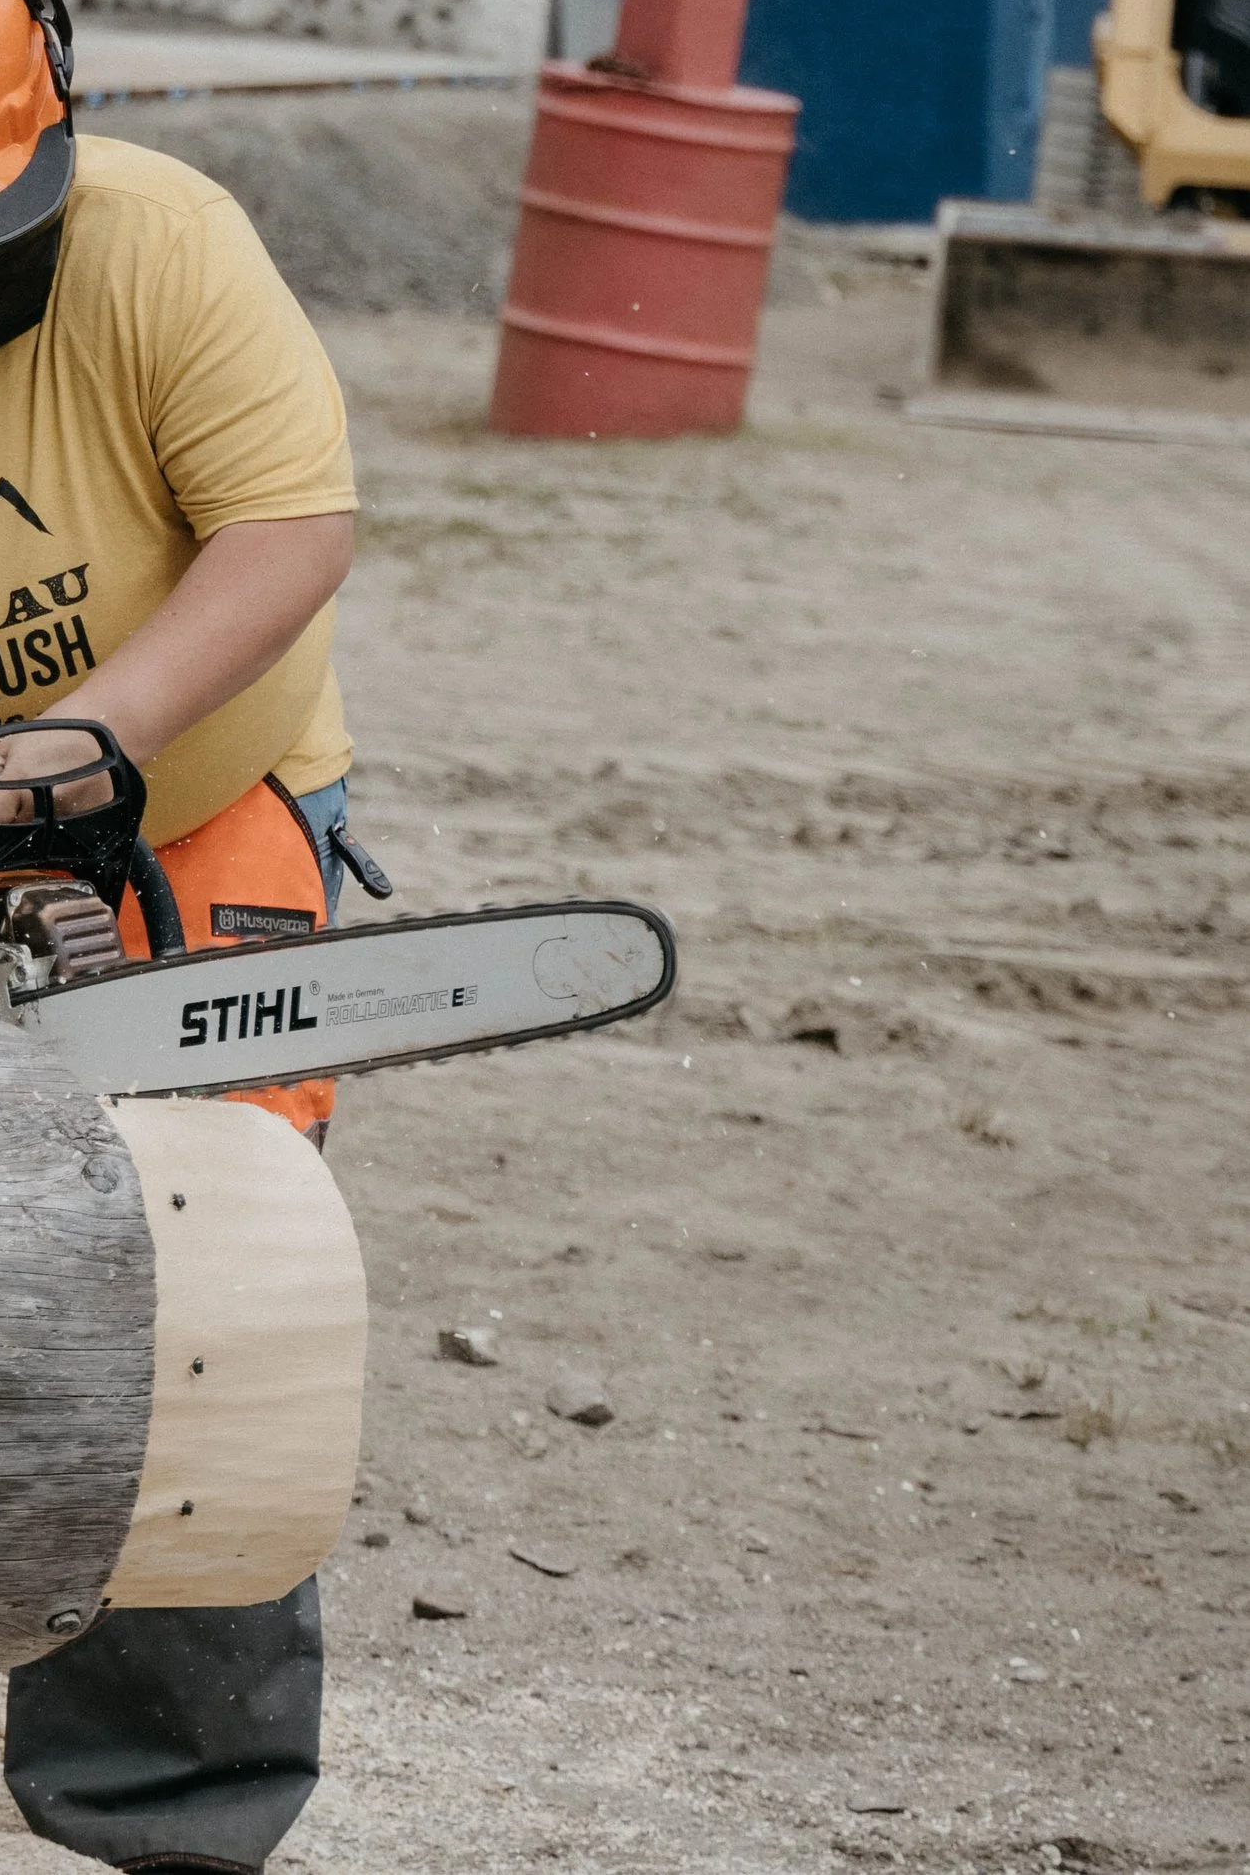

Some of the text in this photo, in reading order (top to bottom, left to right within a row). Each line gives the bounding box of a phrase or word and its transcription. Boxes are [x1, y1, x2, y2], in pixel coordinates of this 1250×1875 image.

[236, 912, 310, 933] Husqvarna
[326, 985, 479, 1026] ROLLOMATIC ES
[327, 993, 346, 1003] Made
[355, 987, 386, 999] Germany
[180, 986, 318, 1048] STIHL
